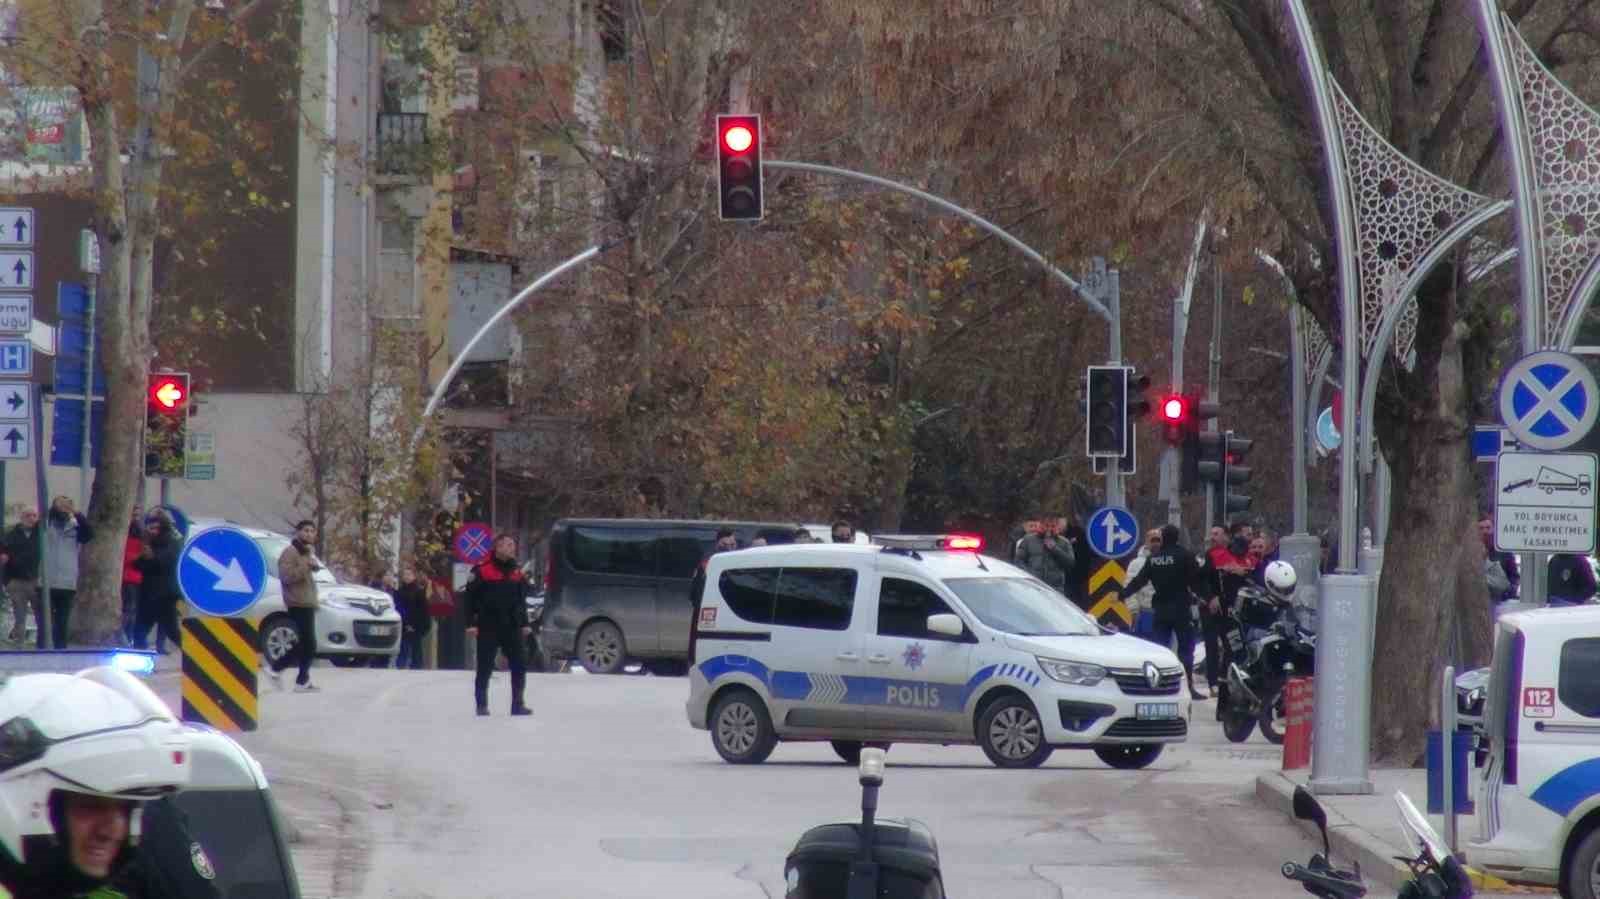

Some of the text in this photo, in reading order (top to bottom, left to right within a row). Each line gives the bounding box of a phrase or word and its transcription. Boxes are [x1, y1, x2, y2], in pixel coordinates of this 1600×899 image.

[1514, 512, 1578, 521] YOL BOYUNCA
[1533, 526, 1588, 535] PARKETMEK
[886, 681, 940, 707] POLİS
[1527, 690, 1551, 705] 112
